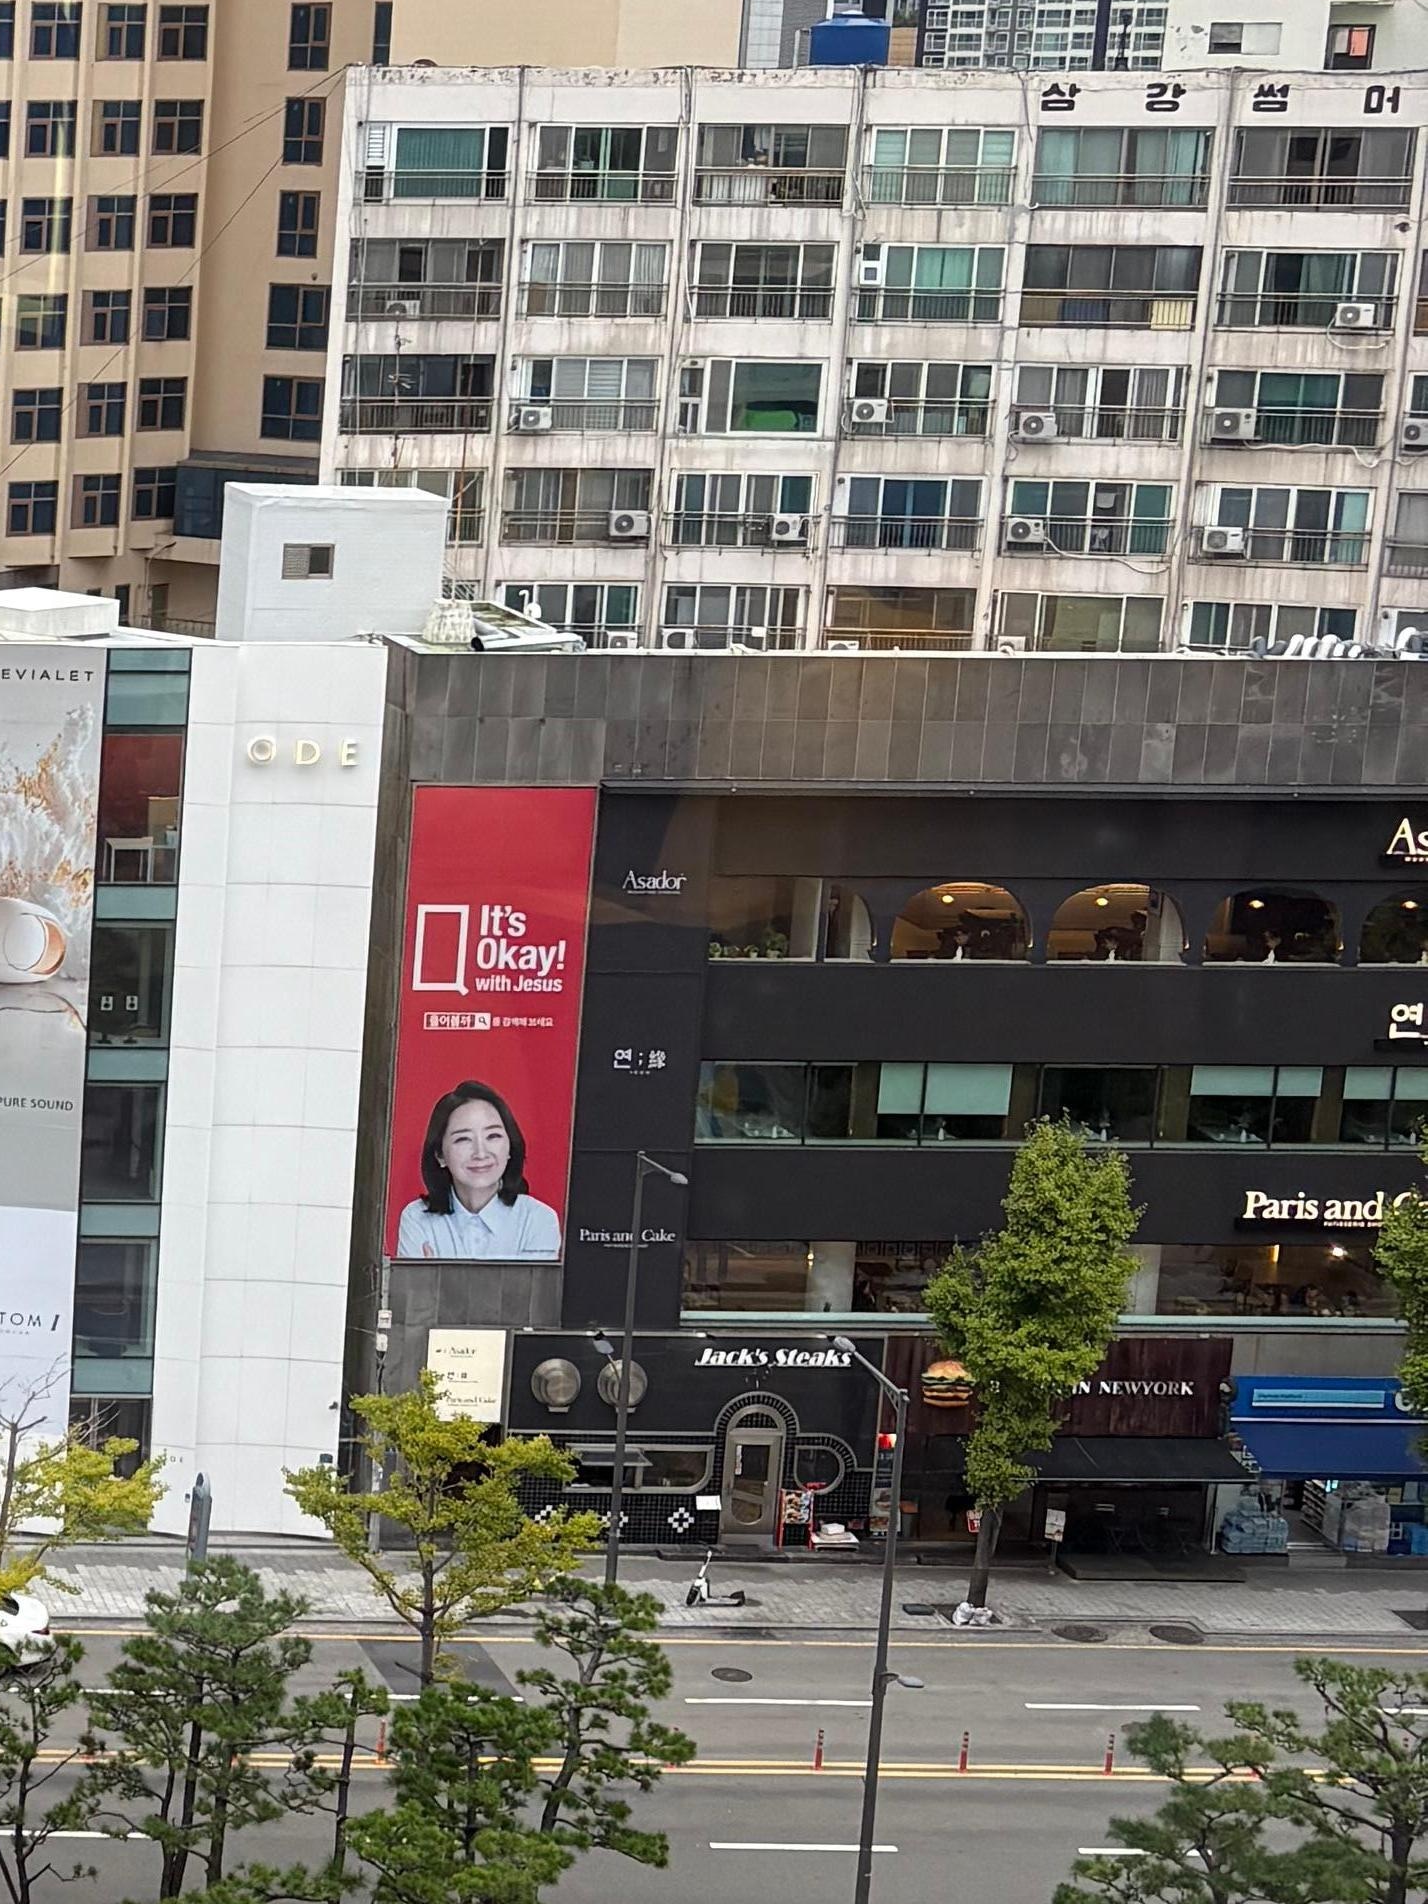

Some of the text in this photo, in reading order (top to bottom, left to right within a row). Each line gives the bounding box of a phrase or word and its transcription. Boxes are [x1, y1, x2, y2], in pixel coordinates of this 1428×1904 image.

[247, 736, 360, 767] ODE
[623, 870, 687, 891] Asador
[480, 904, 527, 937] It's
[476, 937, 567, 977] Okay!
[475, 975, 563, 992] with Jesus
[30, 1098, 74, 1111] SOUND
[1243, 1190, 1319, 1219] Paris
[1323, 1191, 1385, 1220] and
[580, 1228, 611, 1242] Paris
[641, 1228, 676, 1242] Cake
[694, 1347, 853, 1368] Jack's Steaks
[1099, 1380, 1195, 1396] NEWYORK
